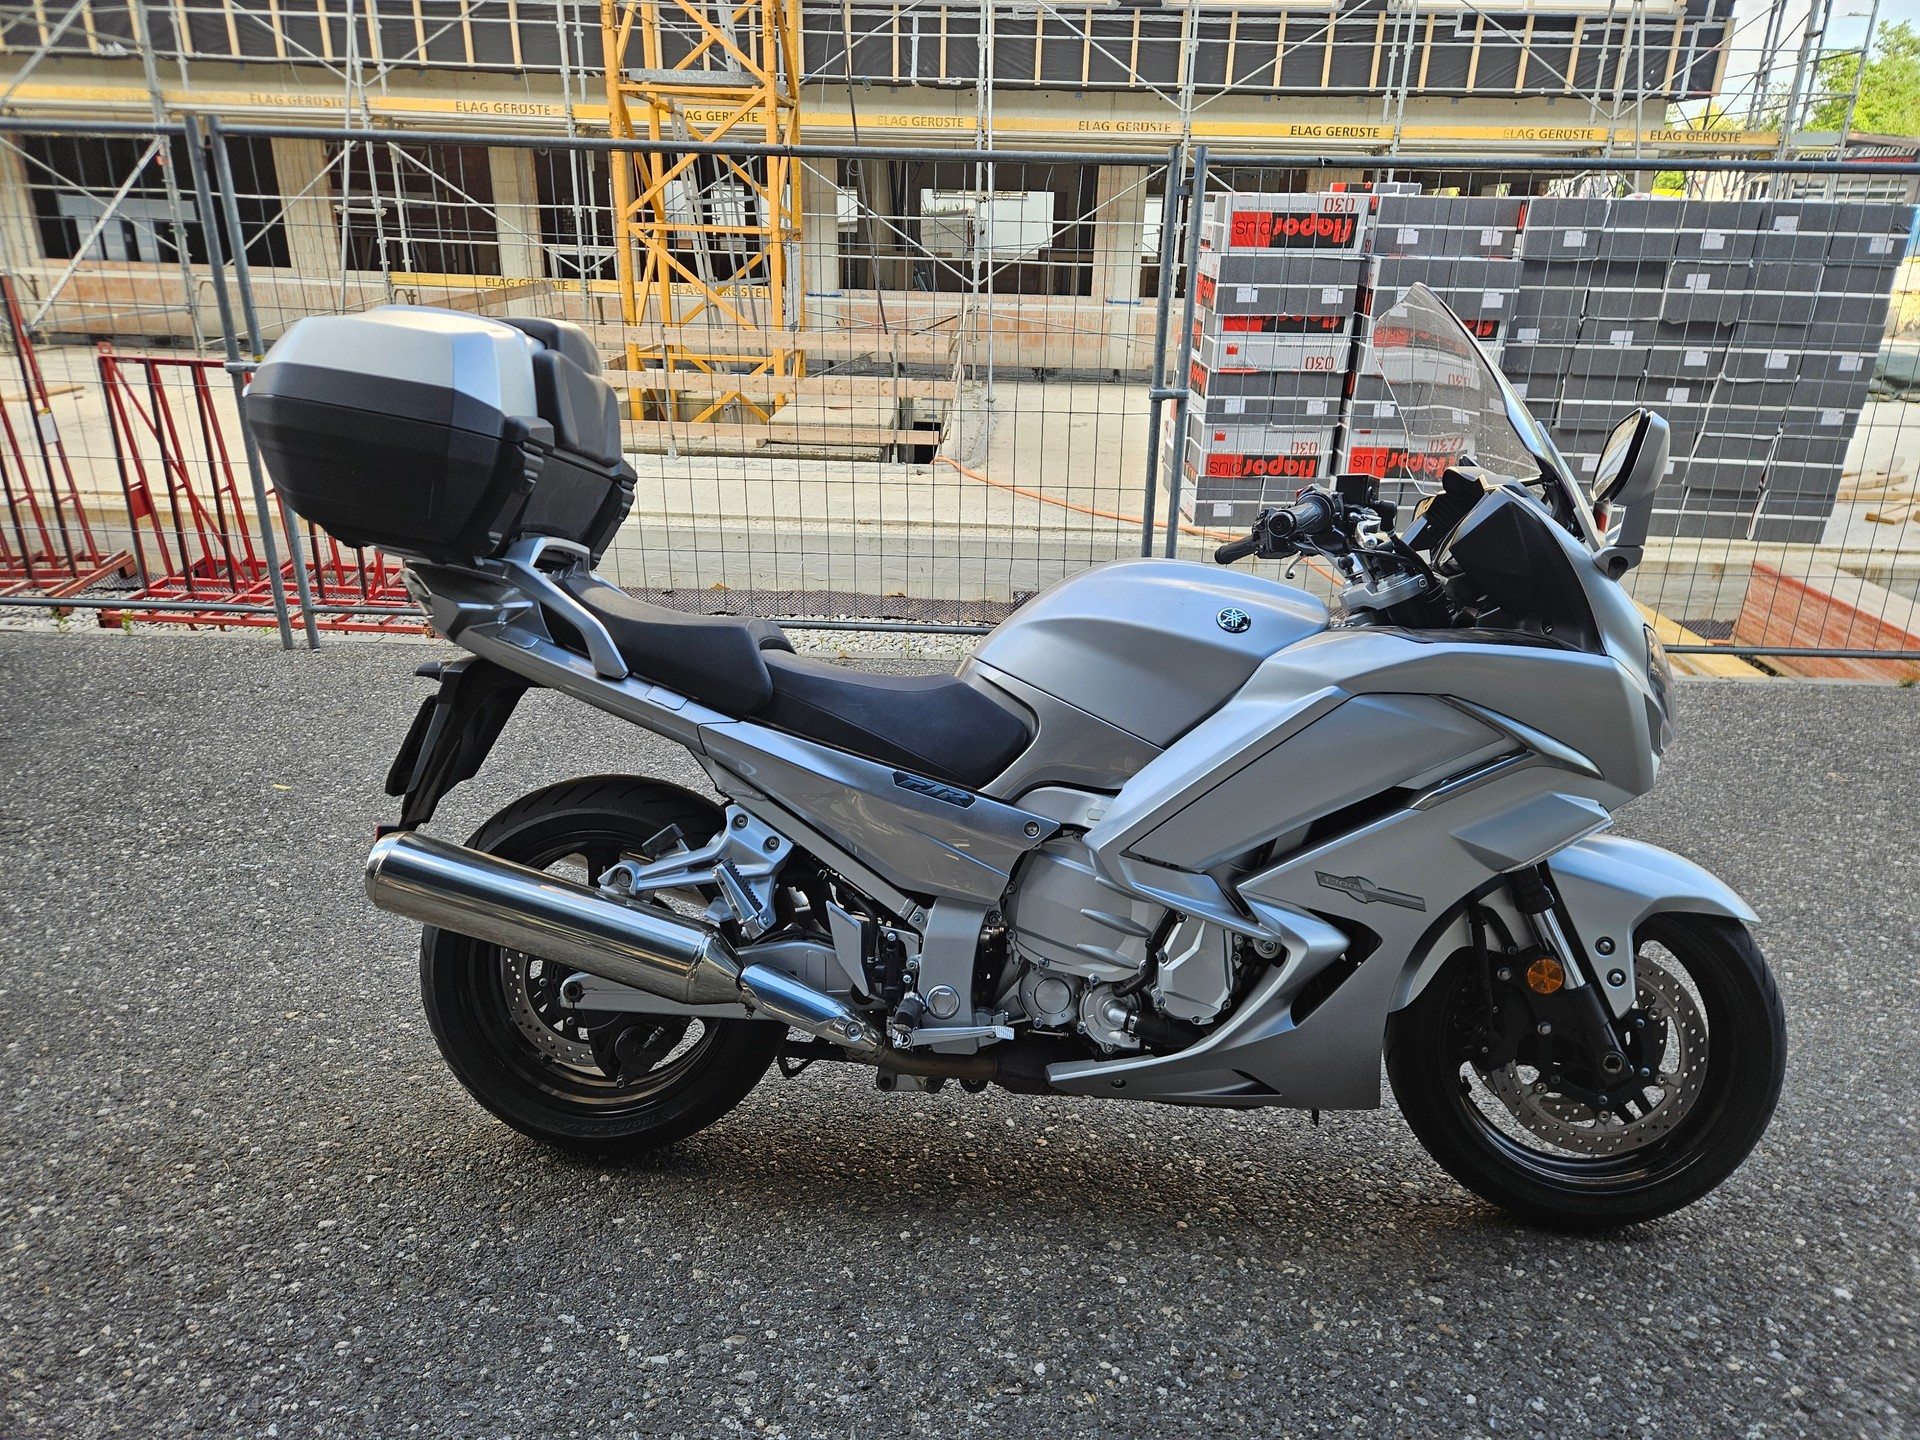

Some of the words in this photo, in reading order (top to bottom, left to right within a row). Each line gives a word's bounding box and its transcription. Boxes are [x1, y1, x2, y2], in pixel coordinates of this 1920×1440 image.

[456, 101, 488, 113] ELAG
[706, 111, 758, 122] GERSTE
[877, 116, 908, 126] ELAG
[1078, 120, 1110, 131] ELAG
[1290, 125, 1321, 136] ELAG
[1503, 128, 1534, 139] ELAG
[1650, 130, 1681, 141] ELAG
[1324, 198, 1355, 213] 030
[1273, 213, 1353, 244] flapor
[485, 277, 514, 288] ELAG
[1305, 356, 1334, 370] 030
[1290, 442, 1318, 455] 030
[1209, 458, 1242, 477] plus
[1243, 455, 1316, 479] flapor
